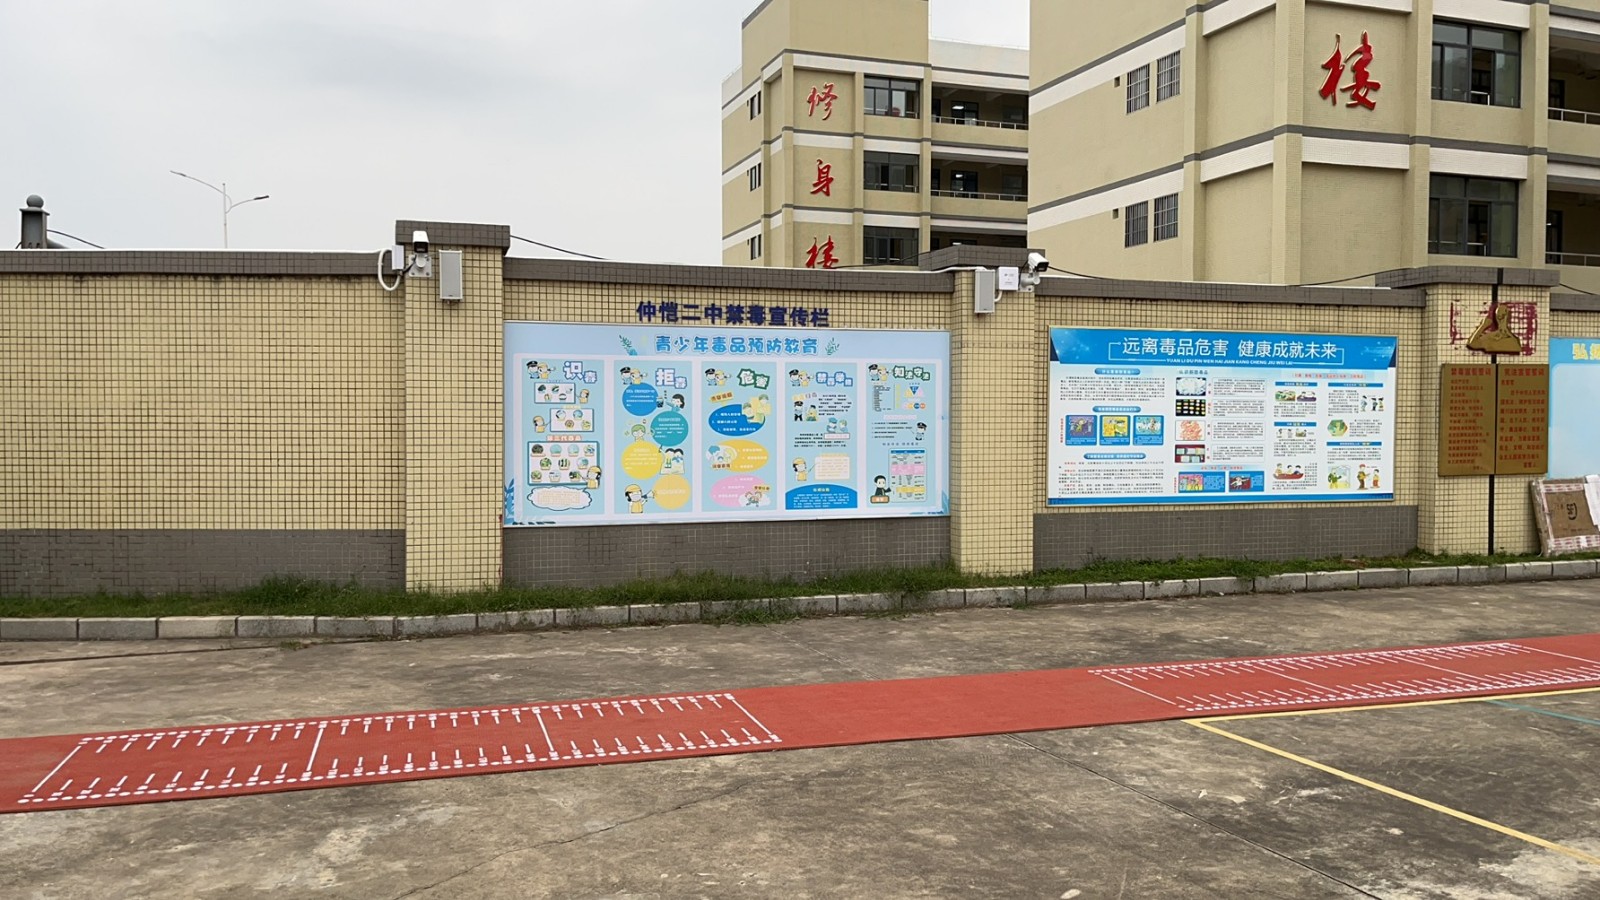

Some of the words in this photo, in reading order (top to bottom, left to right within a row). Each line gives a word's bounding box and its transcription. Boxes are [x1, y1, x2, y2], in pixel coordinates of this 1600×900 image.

[1319, 30, 1382, 111] 楼
[636, 301, 830, 328] 仲恺二中禁毒宣传栏
[655, 336, 819, 354] 青少年毒品预防教育
[1122, 337, 1229, 357] 远离毒品危害
[1238, 339, 1337, 359] 健康成就未来
